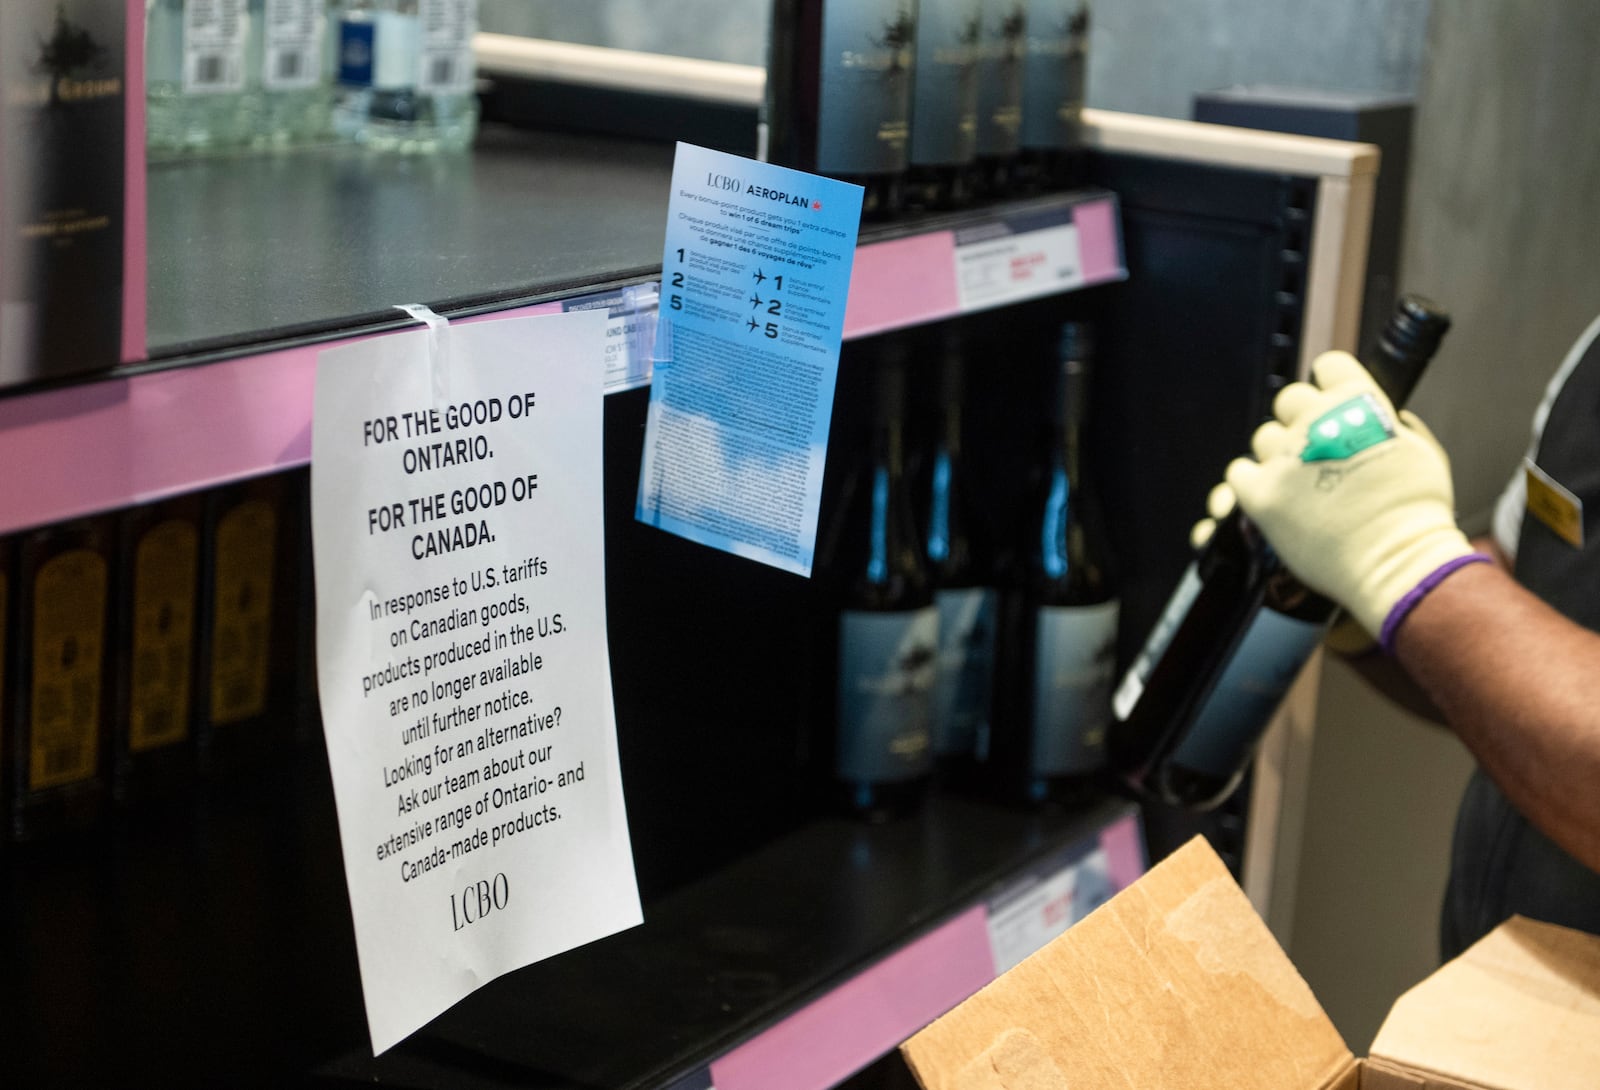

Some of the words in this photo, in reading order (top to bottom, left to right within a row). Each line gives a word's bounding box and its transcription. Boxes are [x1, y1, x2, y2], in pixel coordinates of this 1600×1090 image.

[707, 172, 740, 192] LCBO
[746, 185, 809, 209] AEROPLAN
[672, 272, 684, 288] 2
[677, 248, 684, 263] 1
[671, 295, 682, 310] 5
[768, 300, 781, 316] 2
[774, 275, 783, 290] 1
[764, 323, 778, 339] 5
[364, 415, 399, 446] FOR
[402, 409, 441, 438] THE
[446, 398, 502, 430] GOOD
[508, 393, 536, 418] OF
[403, 436, 494, 474] ONTARIO.
[368, 506, 405, 535] FOR
[408, 493, 447, 524] THE
[451, 482, 506, 516] GOOD
[511, 475, 538, 501] OF
[412, 519, 495, 560] CANADA.
[370, 600, 382, 621] In
[384, 585, 449, 616] response
[452, 579, 468, 596] to
[471, 568, 500, 592] U.S.
[502, 557, 548, 584] tariffs
[390, 629, 407, 647] on
[410, 608, 477, 641] Canadian
[481, 594, 529, 627] goods,
[363, 657, 421, 697] products
[424, 632, 491, 676] produced
[494, 632, 507, 650] in
[510, 624, 534, 646] the
[537, 614, 567, 638] U.S.
[389, 697, 409, 717] are
[412, 689, 428, 708] no
[431, 674, 477, 701] longer
[480, 652, 543, 686] available
[402, 717, 430, 746] until
[433, 704, 481, 731] further
[484, 691, 533, 718] notice.
[383, 754, 432, 788] Looking
[434, 746, 453, 767] for
[457, 739, 474, 758] an
[477, 707, 562, 750] alternative?
[397, 794, 420, 816] Ask
[422, 784, 442, 804] our
[445, 769, 480, 797] team
[483, 751, 525, 781] about
[528, 745, 552, 762] our
[376, 820, 433, 861] extensive
[434, 803, 472, 834] range
[475, 792, 490, 815] of
[493, 776, 553, 809] Ontario-
[557, 762, 585, 788] and
[401, 829, 488, 883] Canada-made
[492, 804, 562, 847] products.
[450, 872, 510, 932] LCBO
